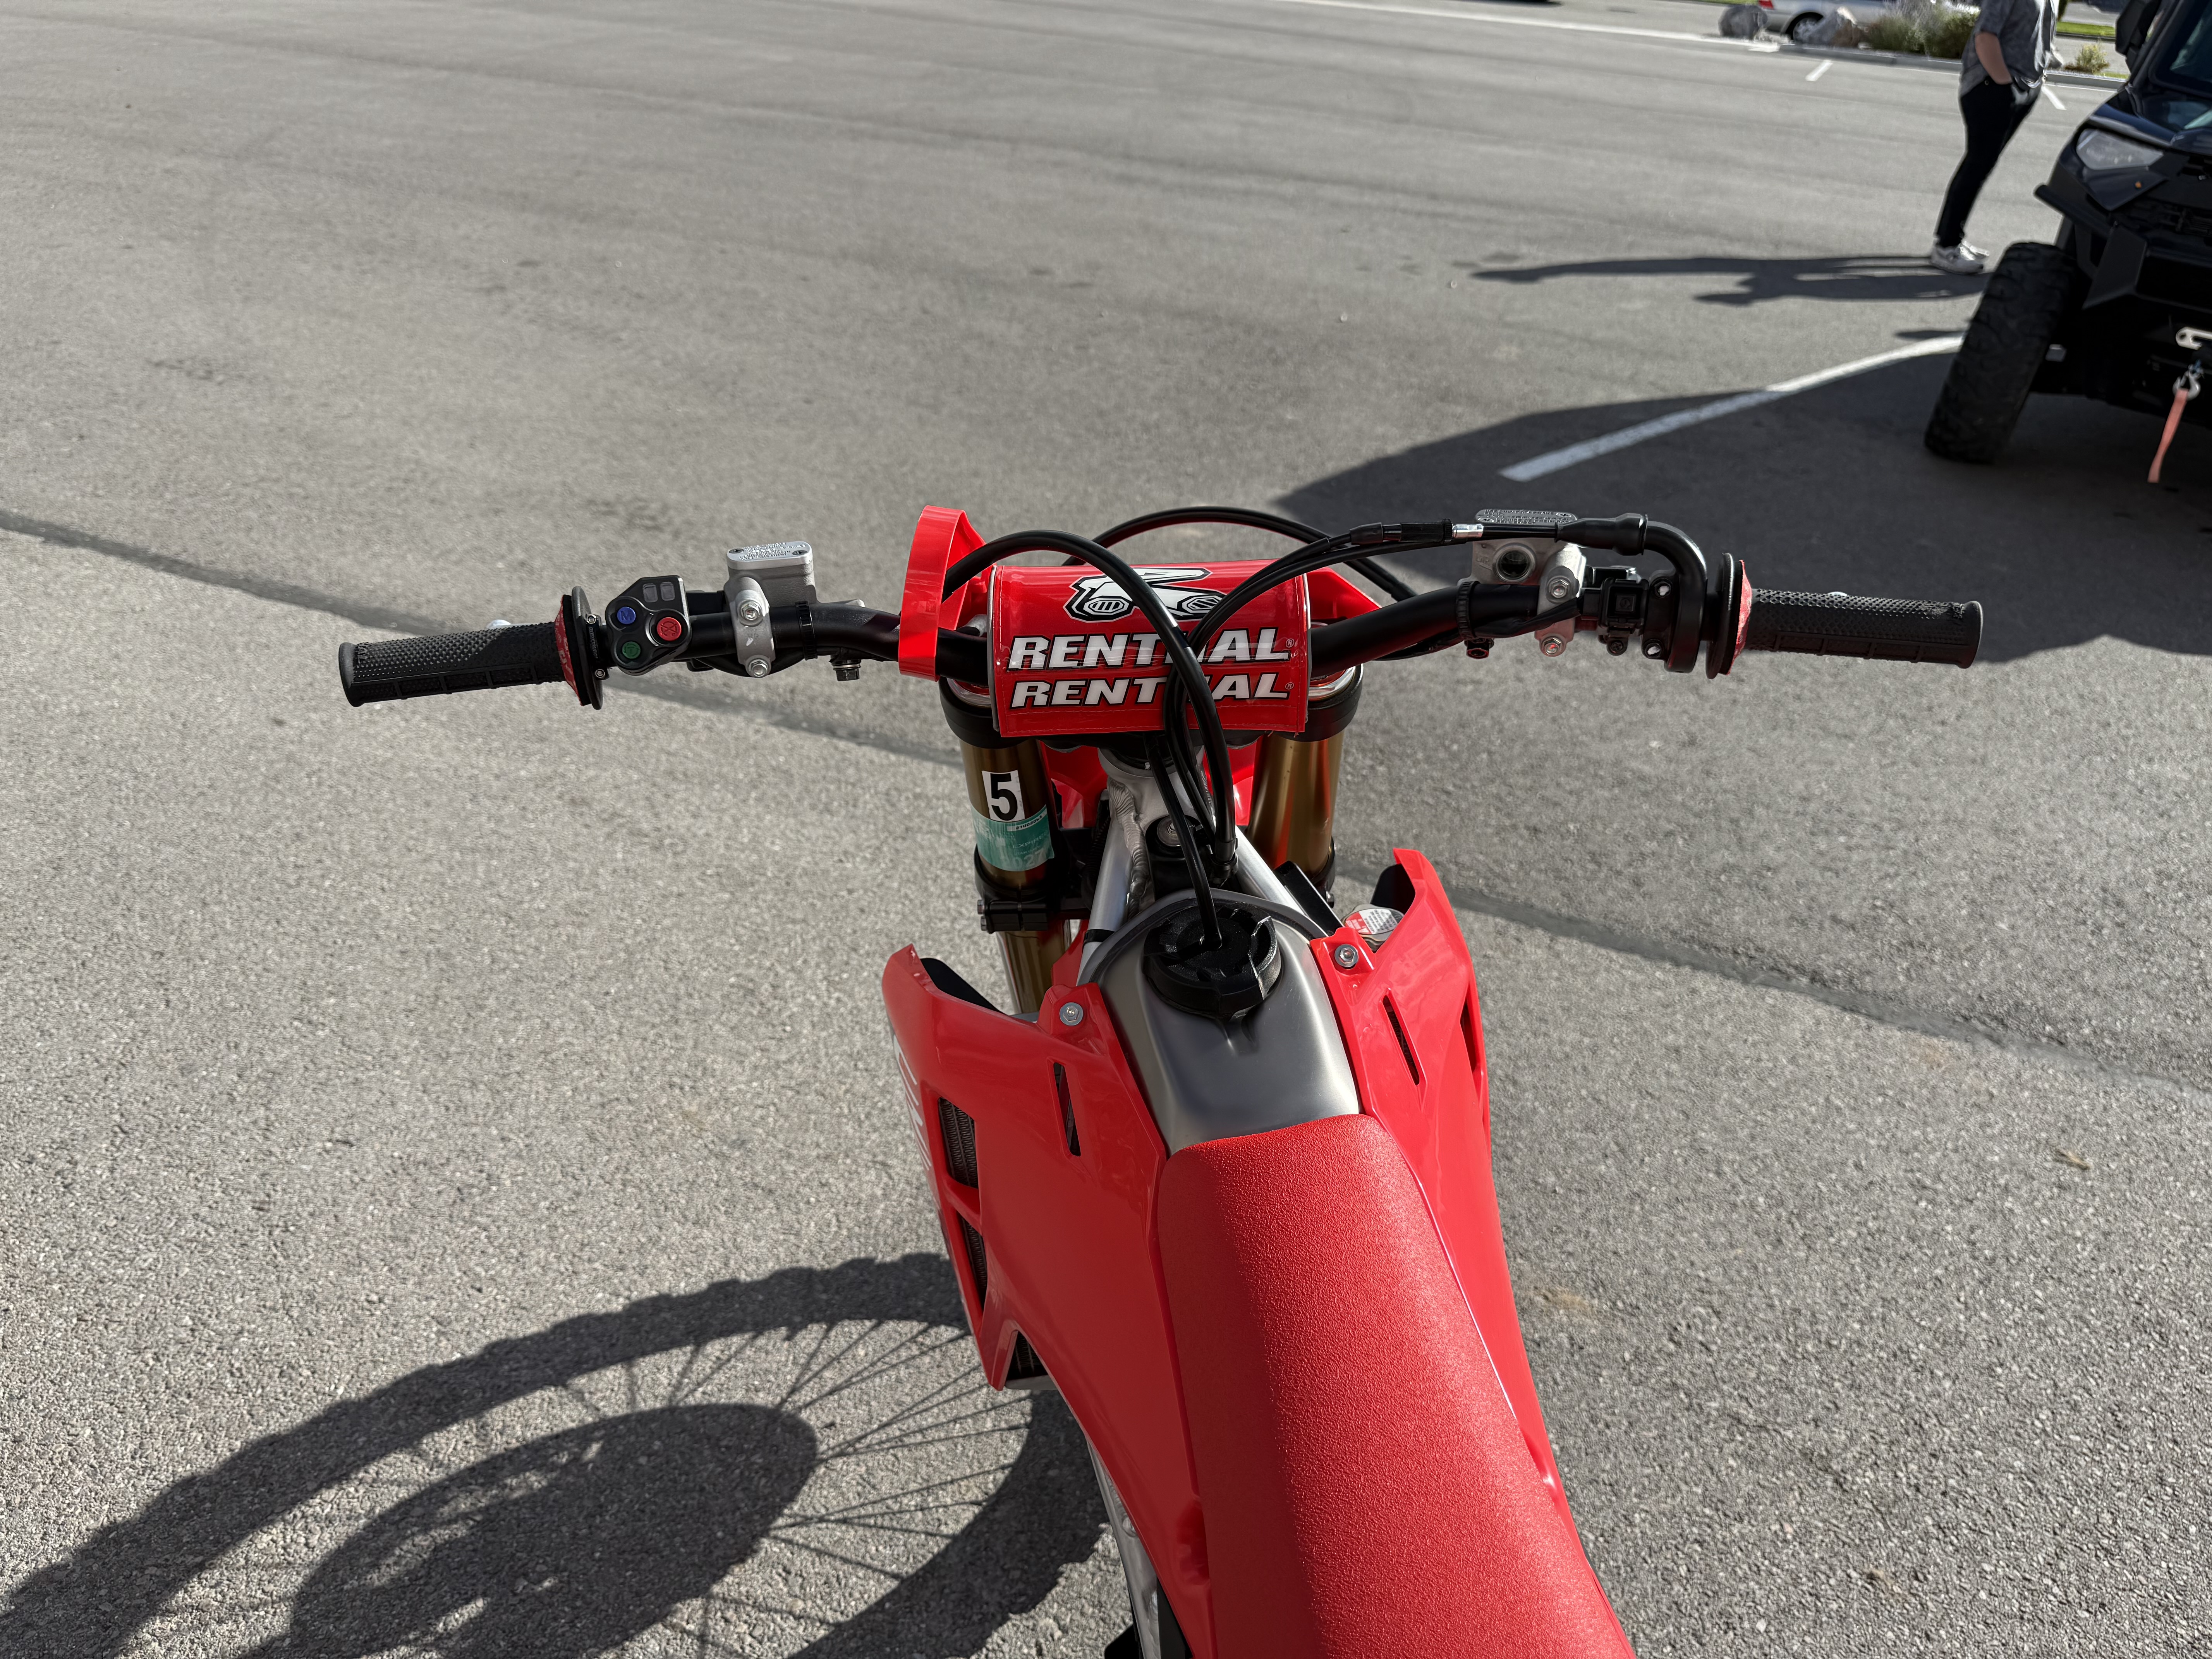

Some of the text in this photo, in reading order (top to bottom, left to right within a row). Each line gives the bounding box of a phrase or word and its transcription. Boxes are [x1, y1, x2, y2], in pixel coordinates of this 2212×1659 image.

[620, 610, 631, 621] M
[1008, 627, 1290, 670] RENTAL
[1010, 673, 1289, 708] RENTAL
[990, 773, 1018, 821] 5
